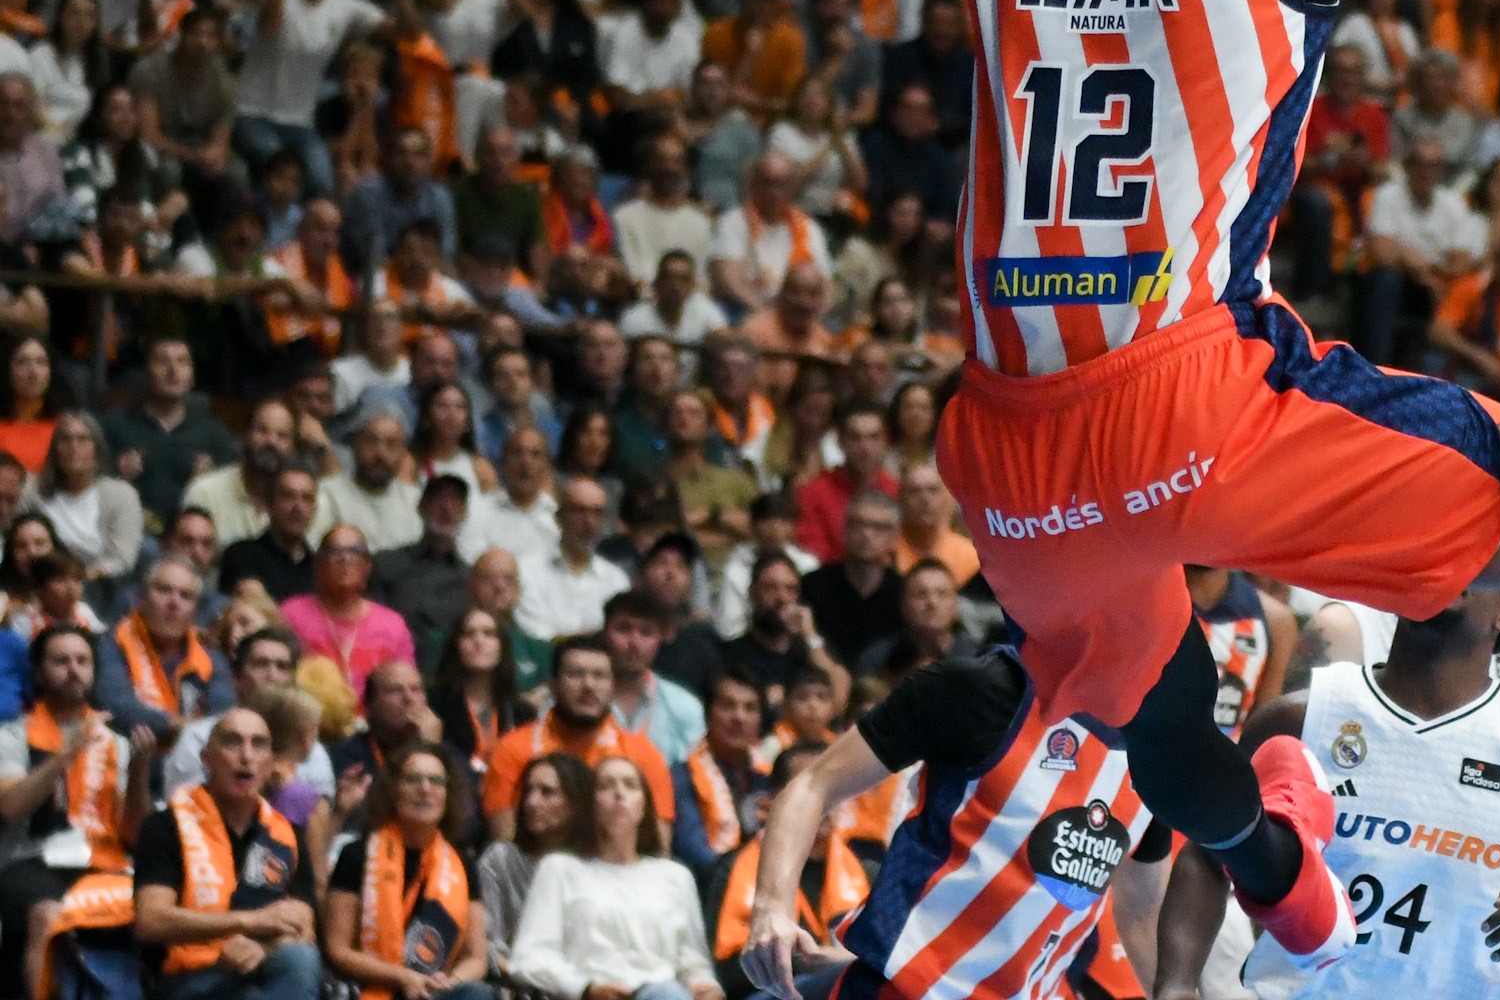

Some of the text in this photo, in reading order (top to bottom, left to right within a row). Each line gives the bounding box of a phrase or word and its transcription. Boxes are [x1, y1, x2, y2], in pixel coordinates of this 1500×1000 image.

[1070, 14, 1126, 31] NATURA
[1018, 65, 1157, 223] 12
[993, 267, 1117, 299] Aluman
[985, 494, 1104, 539] Nordés
[1462, 774, 1500, 790] endesa
[1463, 765, 1482, 778] liga
[1052, 820, 1123, 866] Estrella
[1051, 848, 1110, 888] Galicia
[1349, 874, 1431, 956] 24
